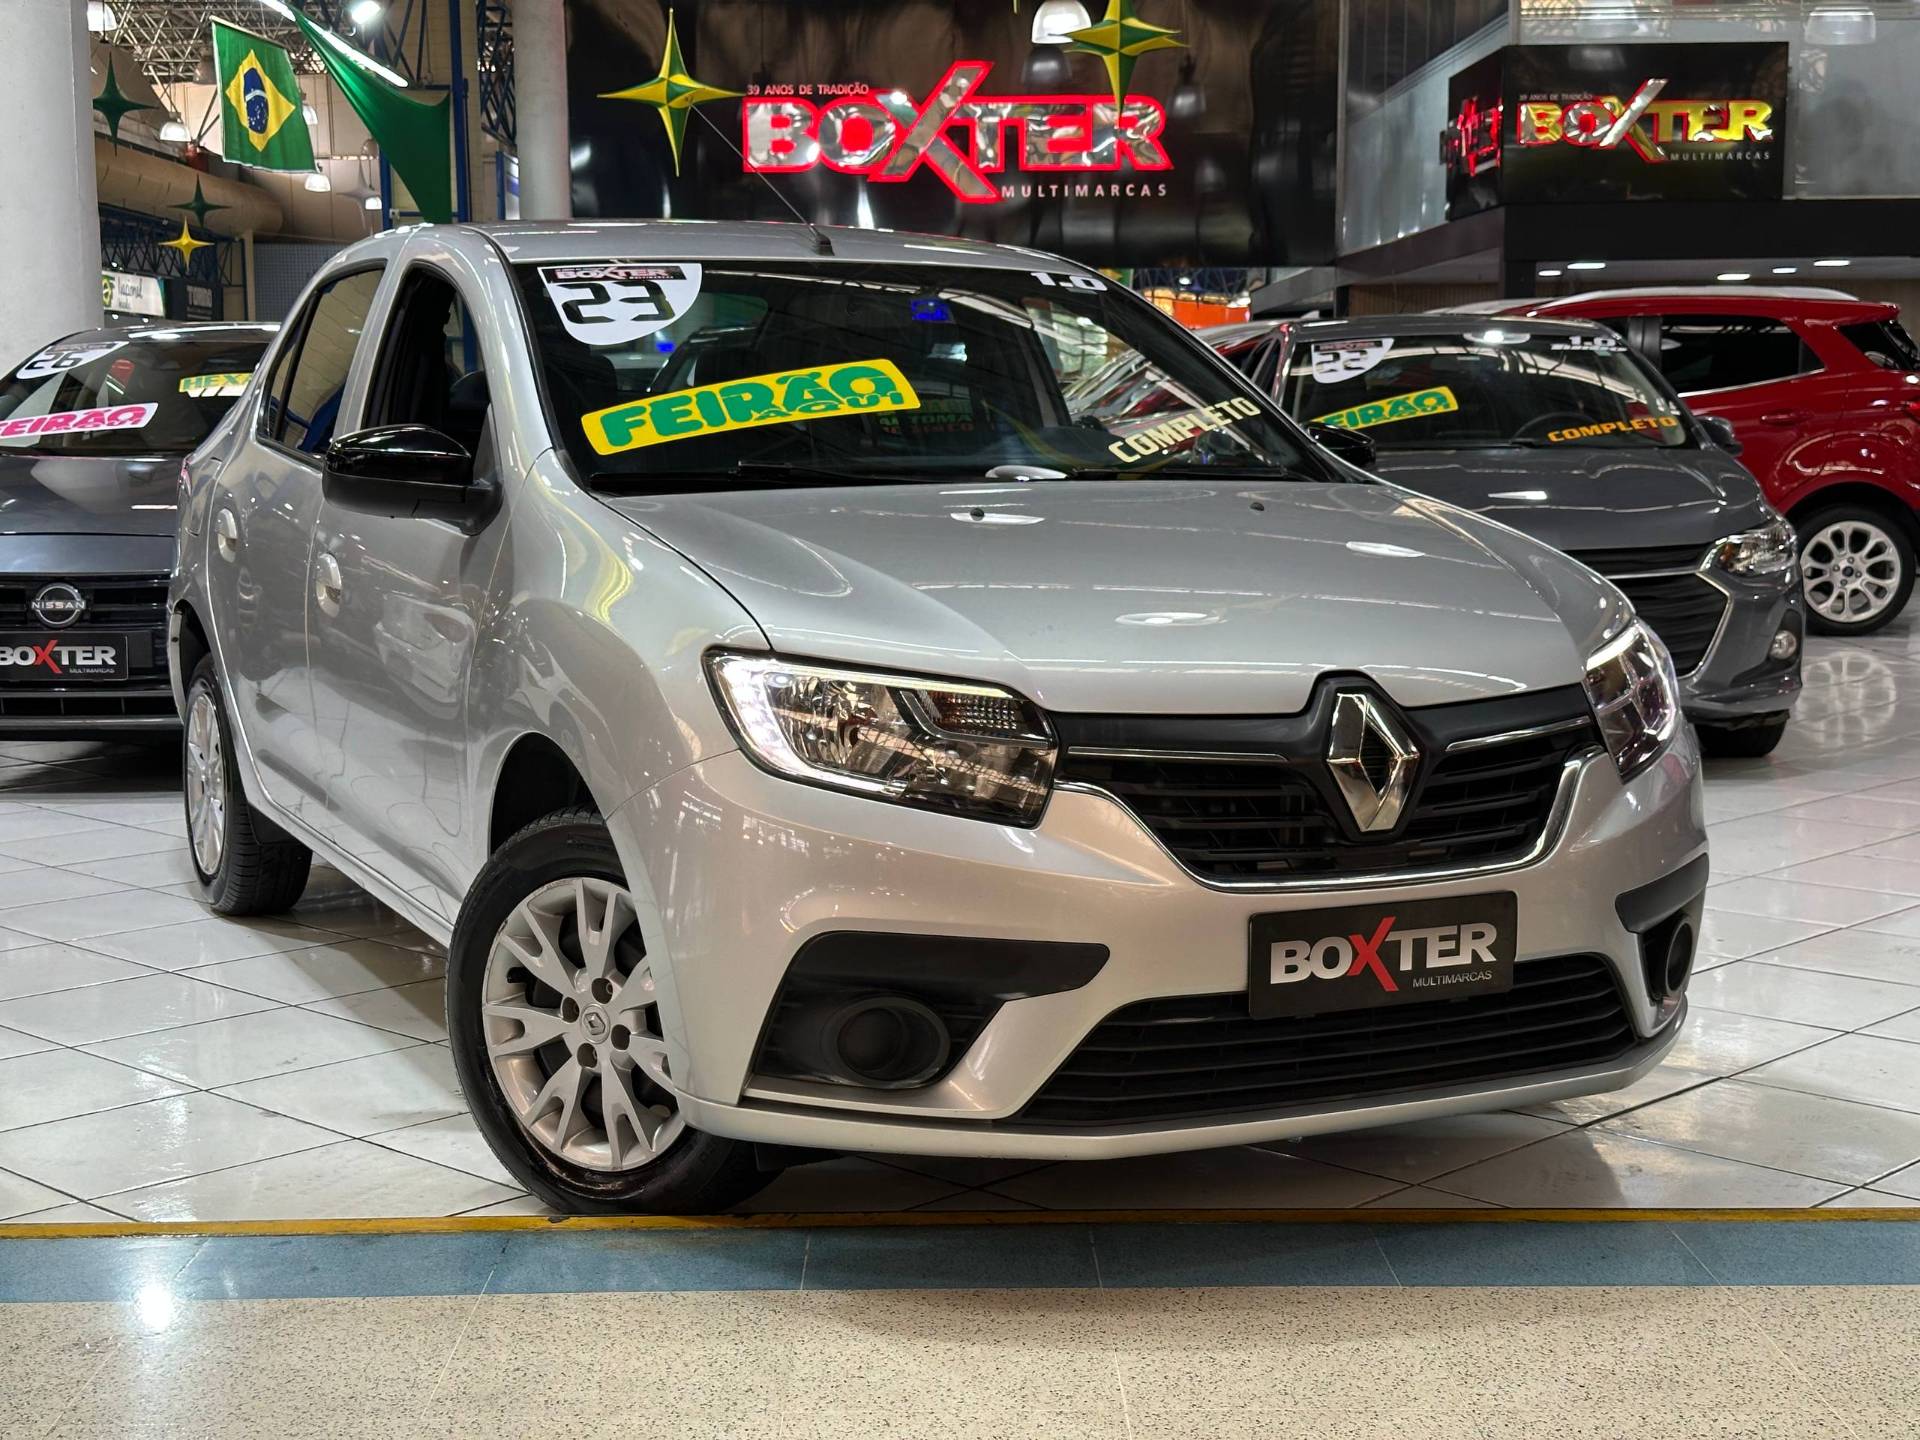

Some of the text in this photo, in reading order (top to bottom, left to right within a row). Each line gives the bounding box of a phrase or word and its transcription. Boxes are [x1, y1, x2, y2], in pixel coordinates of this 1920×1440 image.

[747, 82, 869, 97] 39 ANOS DE TRADIÇÃO
[742, 61, 1174, 204] BOXTER
[1516, 77, 1774, 163] BOXTER
[1668, 150, 1771, 162] MULTIMARCAS
[1001, 183, 1168, 199] MULTIMARCAS
[1030, 271, 1108, 292] 1.0
[556, 281, 676, 325] 23
[1569, 336, 1617, 347] 1.0
[25, 351, 84, 370] 26
[600, 366, 897, 447] FEIRÃO
[753, 391, 905, 421] AQUI
[1321, 391, 1451, 429] EIRÃO
[1108, 397, 1262, 463] COMPLETO
[1548, 416, 1678, 442] COMPLETO
[31, 601, 86, 609] NISSAN
[0, 640, 117, 674] BOXTER
[1270, 916, 1497, 992] BOXTER
[1412, 969, 1493, 989] MULTIMARCAS
